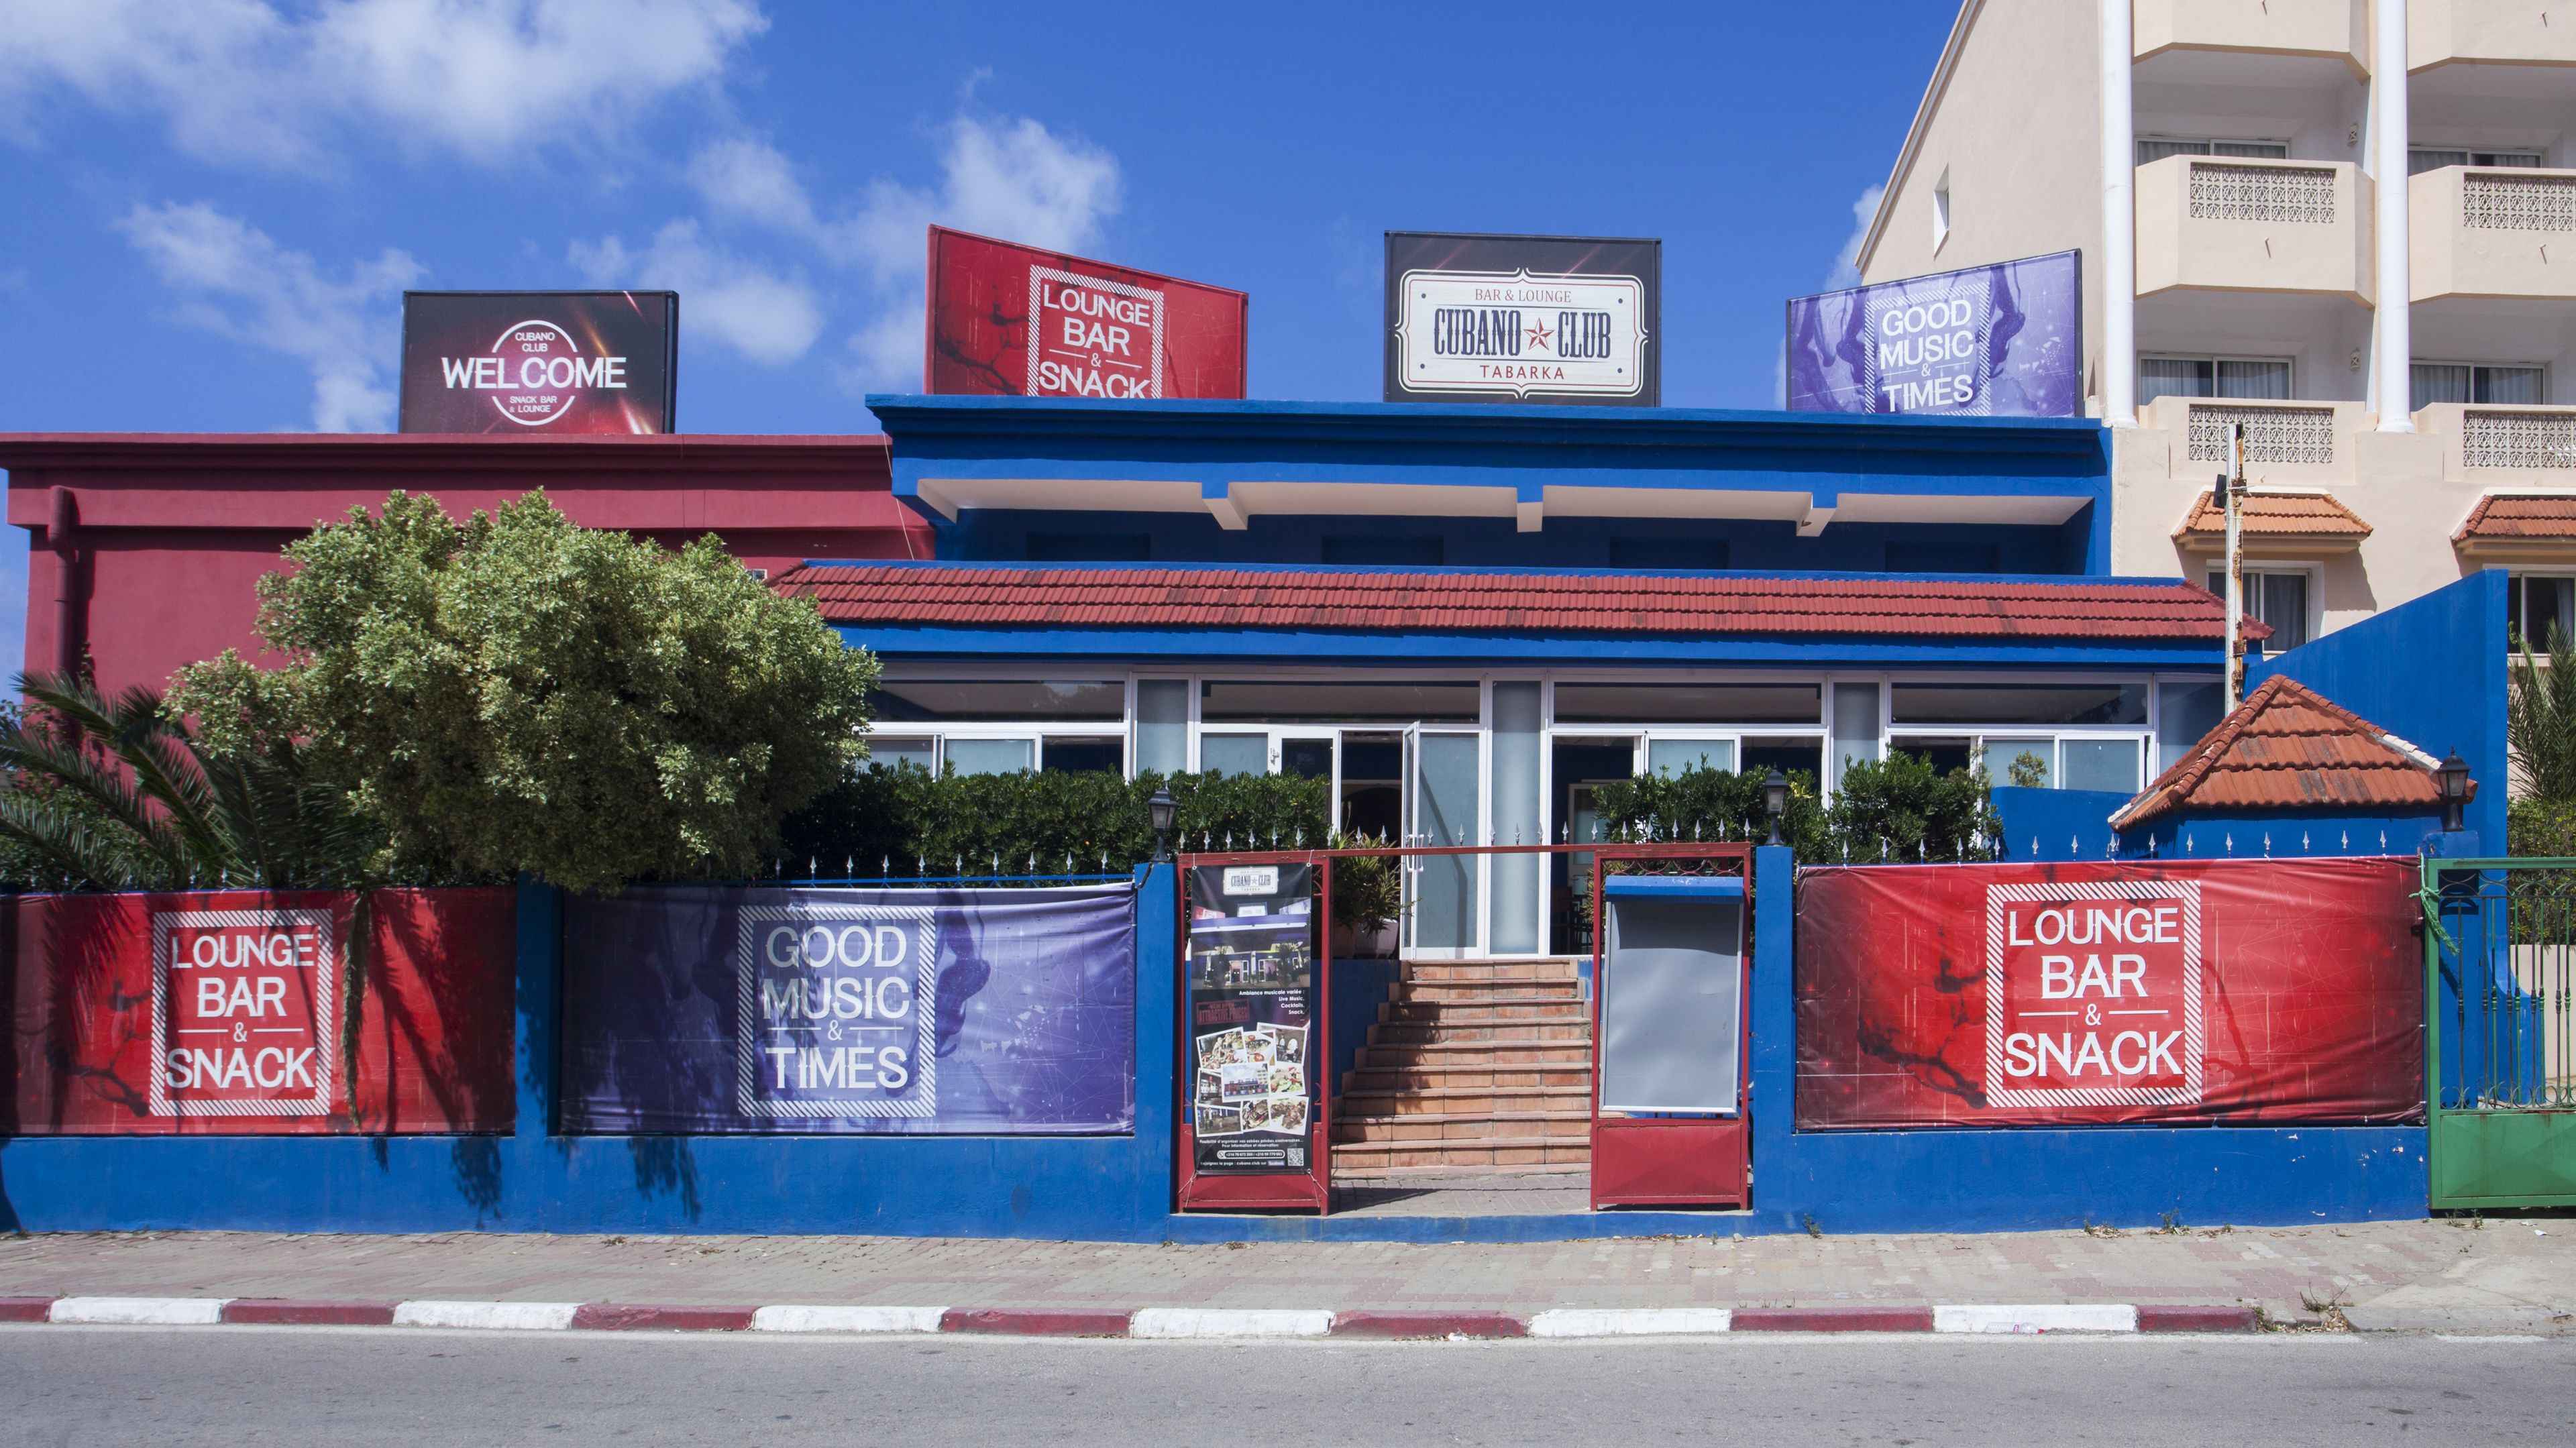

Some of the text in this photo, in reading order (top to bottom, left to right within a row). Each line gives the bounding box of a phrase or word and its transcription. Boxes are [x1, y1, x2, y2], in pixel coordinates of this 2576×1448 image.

[1043, 284, 1150, 327] LOUNGE
[1475, 288, 1572, 302] BAR & LOUNGE
[515, 332, 555, 341] CUBANO
[1063, 317, 1130, 356] BAR
[1434, 309, 1611, 359] CUBANO CLUB
[1882, 299, 1972, 337] GOOD
[521, 343, 548, 352] CLUB
[1091, 353, 1101, 368] &
[1880, 330, 1974, 370] MUSIC
[441, 357, 627, 389] WELCOME
[1039, 361, 1151, 398] SNACK
[1480, 365, 1564, 380] TABARKA
[1921, 363, 1931, 377] &
[509, 396, 557, 404] SNACK BAR
[1882, 374, 1974, 412] TIMES
[1232, 875, 1271, 886] CUBANO CLUB
[2008, 907, 2180, 946] LOUNGE
[171, 934, 315, 968] LOUNGE
[765, 925, 908, 968] GOOD
[2041, 954, 2149, 999] BAR
[197, 977, 288, 1017] BAR
[762, 976, 910, 1019] MUSIC
[2085, 1003, 2102, 1025] &
[233, 1021, 248, 1042] &
[827, 1019, 843, 1041] &
[165, 1047, 316, 1089] SNACK
[765, 1046, 908, 1089] TIMES
[2003, 1030, 2184, 1077] SNACK
